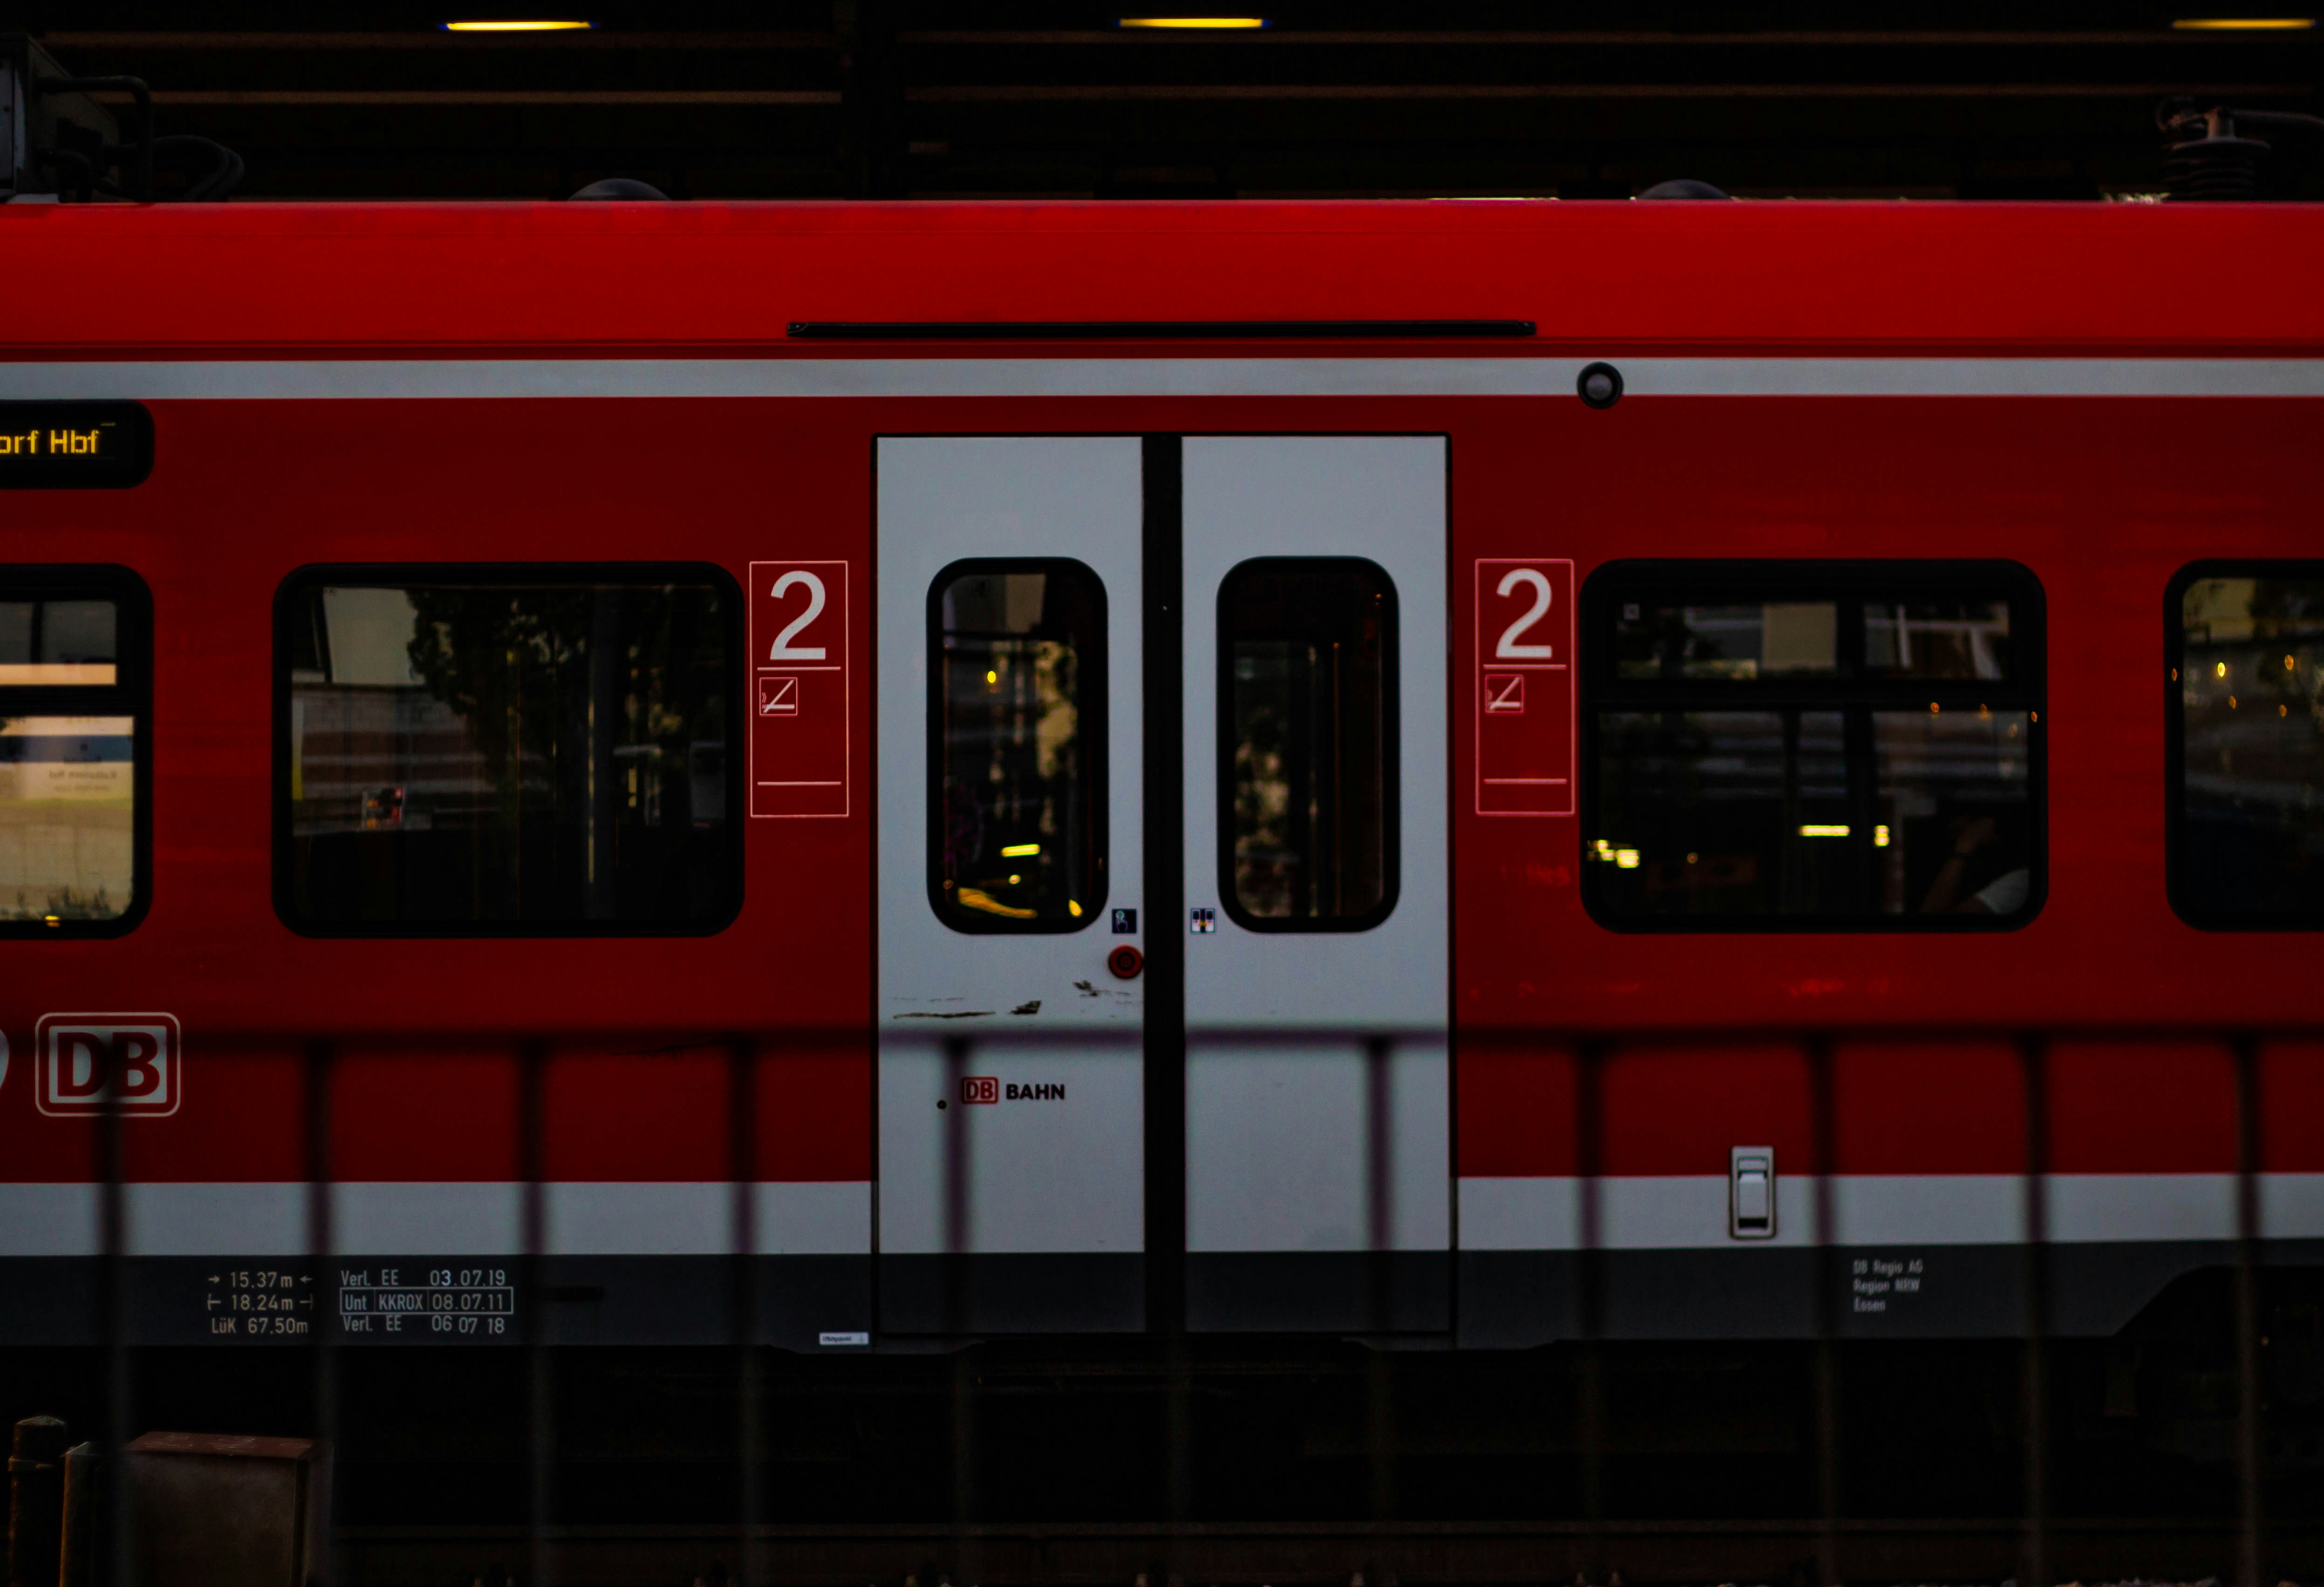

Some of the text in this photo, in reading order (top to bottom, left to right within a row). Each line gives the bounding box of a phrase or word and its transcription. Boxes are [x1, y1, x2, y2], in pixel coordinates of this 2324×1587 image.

[50, 429, 100, 454] Hbf
[770, 570, 827, 661] 2
[1495, 568, 1553, 660] 2
[57, 1032, 160, 1097] DB
[966, 1082, 1065, 1099] DB BAHN
[1852, 1259, 1923, 1277] DB Regio AG
[341, 1269, 506, 1286] Verl. EE 03.07.19
[1852, 1277, 1920, 1295] Region NRW
[344, 1294, 367, 1310] Unt
[432, 1294, 503, 1310] 08.07.11
[1853, 1296, 1886, 1312] Essen
[212, 1317, 308, 1334] LüK 67.50m
[342, 1316, 373, 1332] Verl.
[386, 1315, 401, 1331] EE
